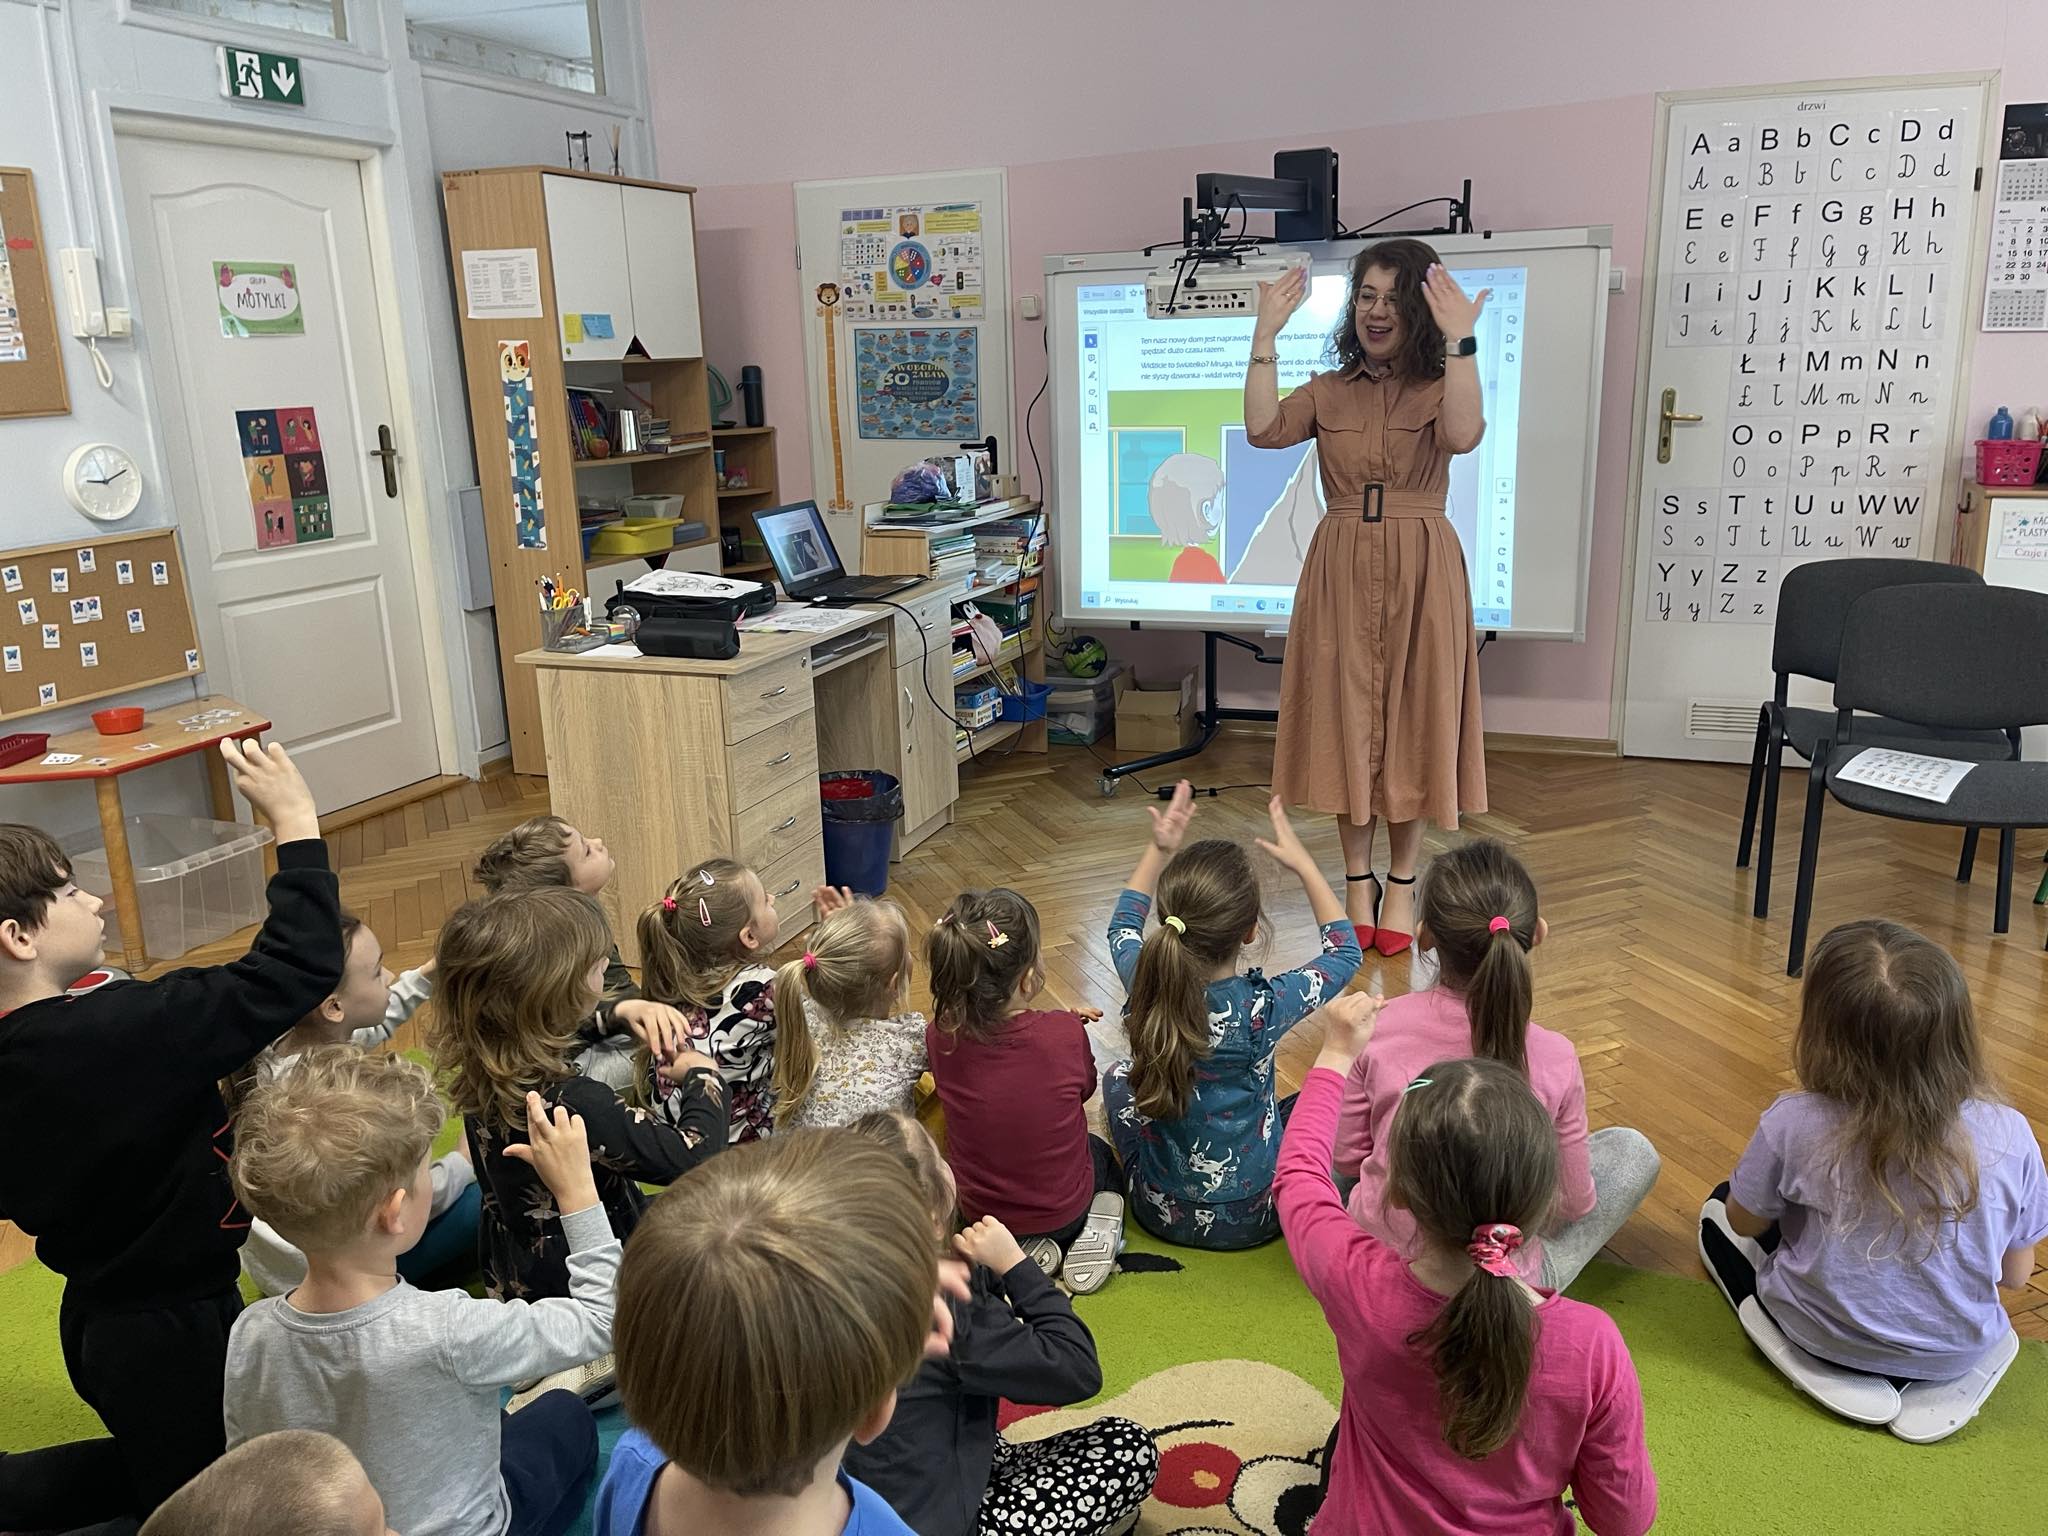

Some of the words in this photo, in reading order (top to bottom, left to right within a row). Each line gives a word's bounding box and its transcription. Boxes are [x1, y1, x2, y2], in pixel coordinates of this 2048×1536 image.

[1797, 100, 1826, 111] drzwi
[1691, 133, 1710, 155] A
[1728, 138, 1740, 152] a
[1761, 129, 1778, 150] B
[1797, 127, 1810, 148] b
[1830, 124, 1849, 146] C
[1868, 129, 1880, 143] c
[1901, 120, 1921, 142] D
[1939, 119, 1953, 139] d
[1686, 209, 1703, 230] E
[1721, 214, 1733, 228] e
[1755, 205, 1771, 227] F
[1792, 204, 1802, 224] f
[1822, 201, 1842, 222] G
[1859, 206, 1873, 225] g
[1894, 198, 1913, 219] H
[1932, 197, 1945, 217] h
[2027, 225, 2033, 233] 2
[2010, 238, 2016, 246] 8
[2039, 249, 2048, 257] 17
[2006, 261, 2017, 269] 22
[2021, 261, 2031, 269] 23
[1718, 283, 1722, 301] i
[1748, 280, 1761, 301] J
[1784, 280, 1791, 303] j
[1816, 277, 1835, 298] K
[1854, 276, 1866, 296] k
[1889, 274, 1903, 295] L
[237, 292, 287, 309] MOTYLKI
[1204, 335, 1216, 344] jest
[1216, 334, 1251, 343] naprawdę
[1140, 347, 1166, 355] spędzać
[1295, 358, 1305, 366] do
[1740, 354, 1755, 373] Ł
[1779, 353, 1785, 372] ł
[1807, 351, 1829, 371] M
[1841, 356, 1862, 370] m
[1878, 349, 1897, 370] N
[1916, 355, 1928, 368] n
[1205, 371, 1222, 379] widzi
[1223, 371, 1244, 380] wtedy
[1733, 425, 1753, 445] O
[1769, 431, 1782, 444] o
[1802, 424, 1820, 444] P
[1837, 430, 1851, 448] p
[1870, 423, 1889, 443] R
[1910, 429, 1919, 443] r
[1663, 496, 1679, 514] S
[1697, 502, 1707, 514] s
[1729, 496, 1745, 514] T
[1765, 498, 1773, 514] t
[1795, 495, 1813, 515] U
[1831, 501, 1843, 514] u
[1859, 495, 1886, 515] W
[1658, 563, 1675, 582] Y
[1691, 570, 1703, 586] y
[1721, 564, 1738, 582] Z
[1757, 570, 1766, 583] z
